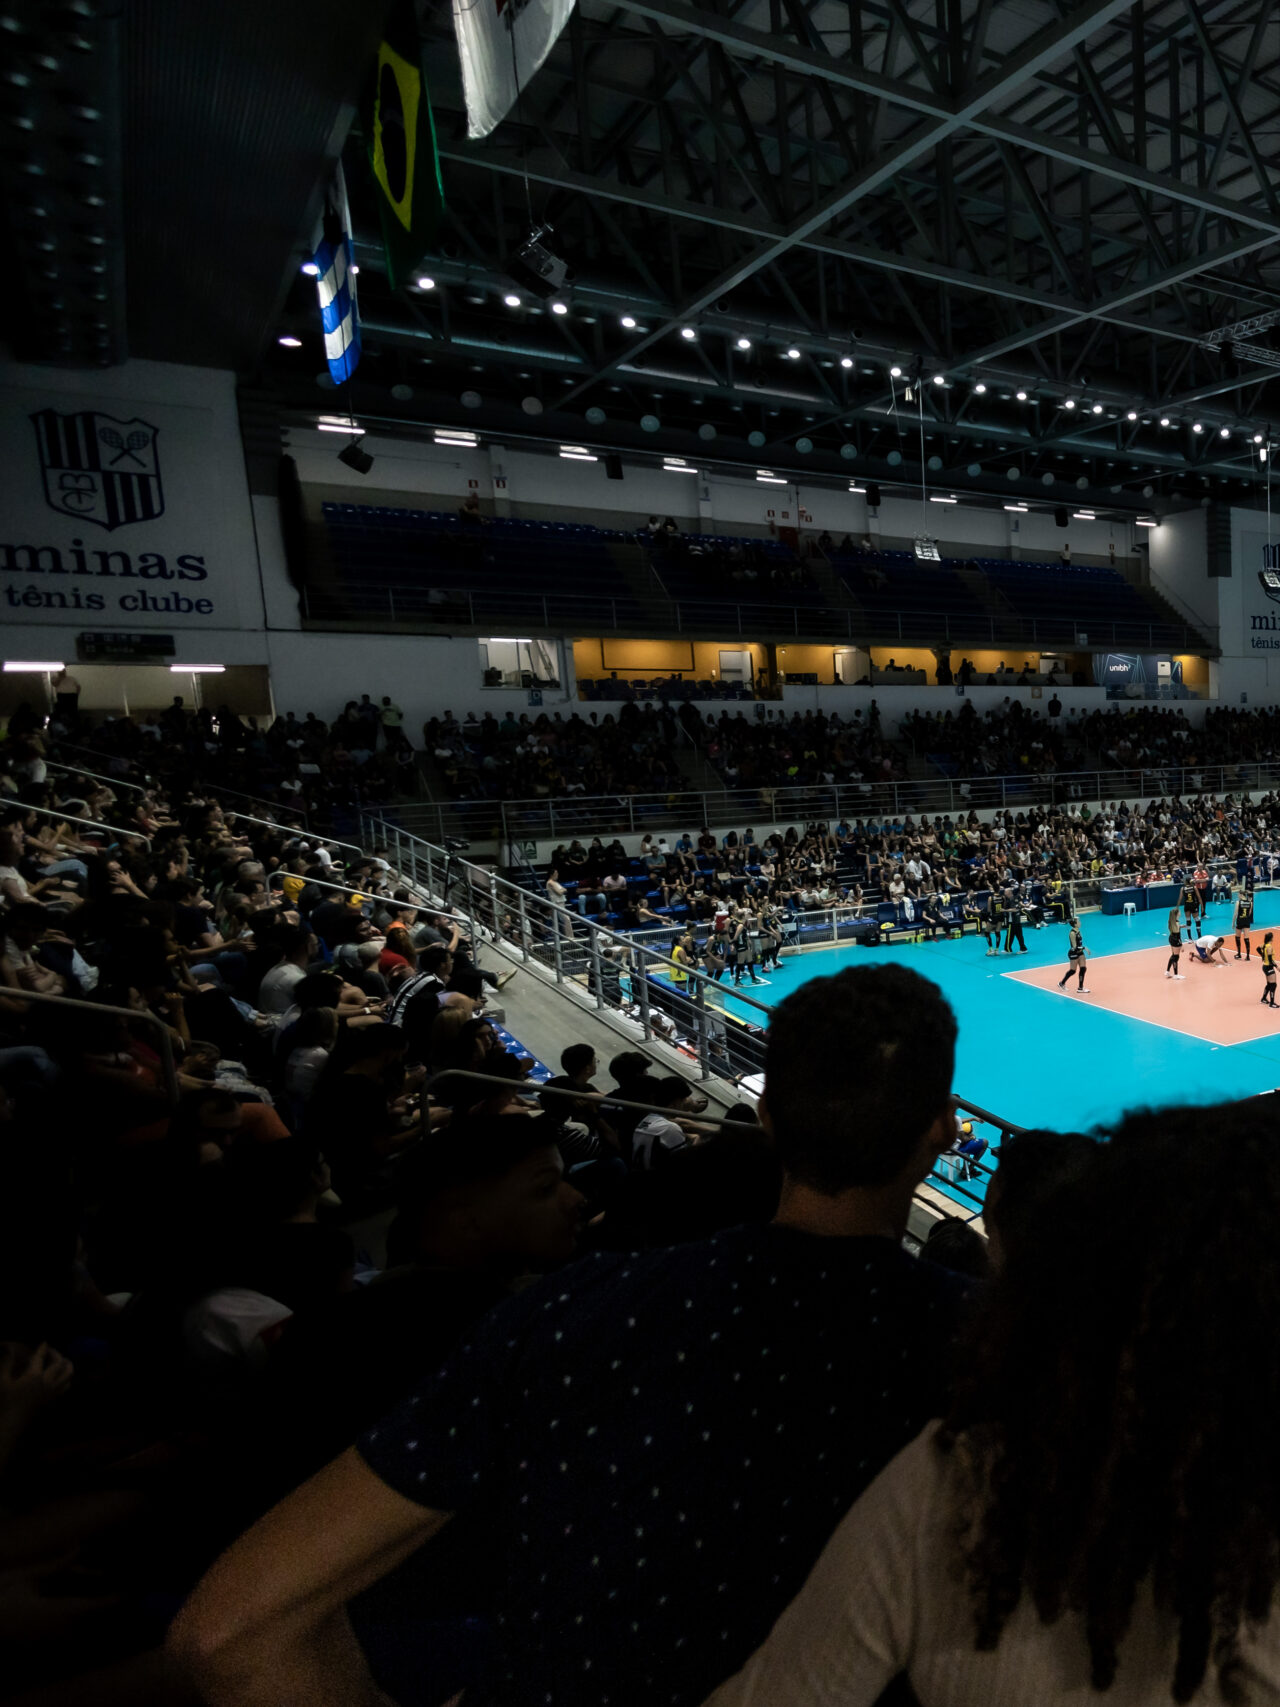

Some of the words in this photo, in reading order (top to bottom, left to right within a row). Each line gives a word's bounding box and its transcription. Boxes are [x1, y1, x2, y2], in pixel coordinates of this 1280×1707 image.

[0, 539, 208, 581] minas
[6, 584, 105, 611] tênis
[119, 589, 214, 615] clube
[1251, 637, 1280, 650] tênis
